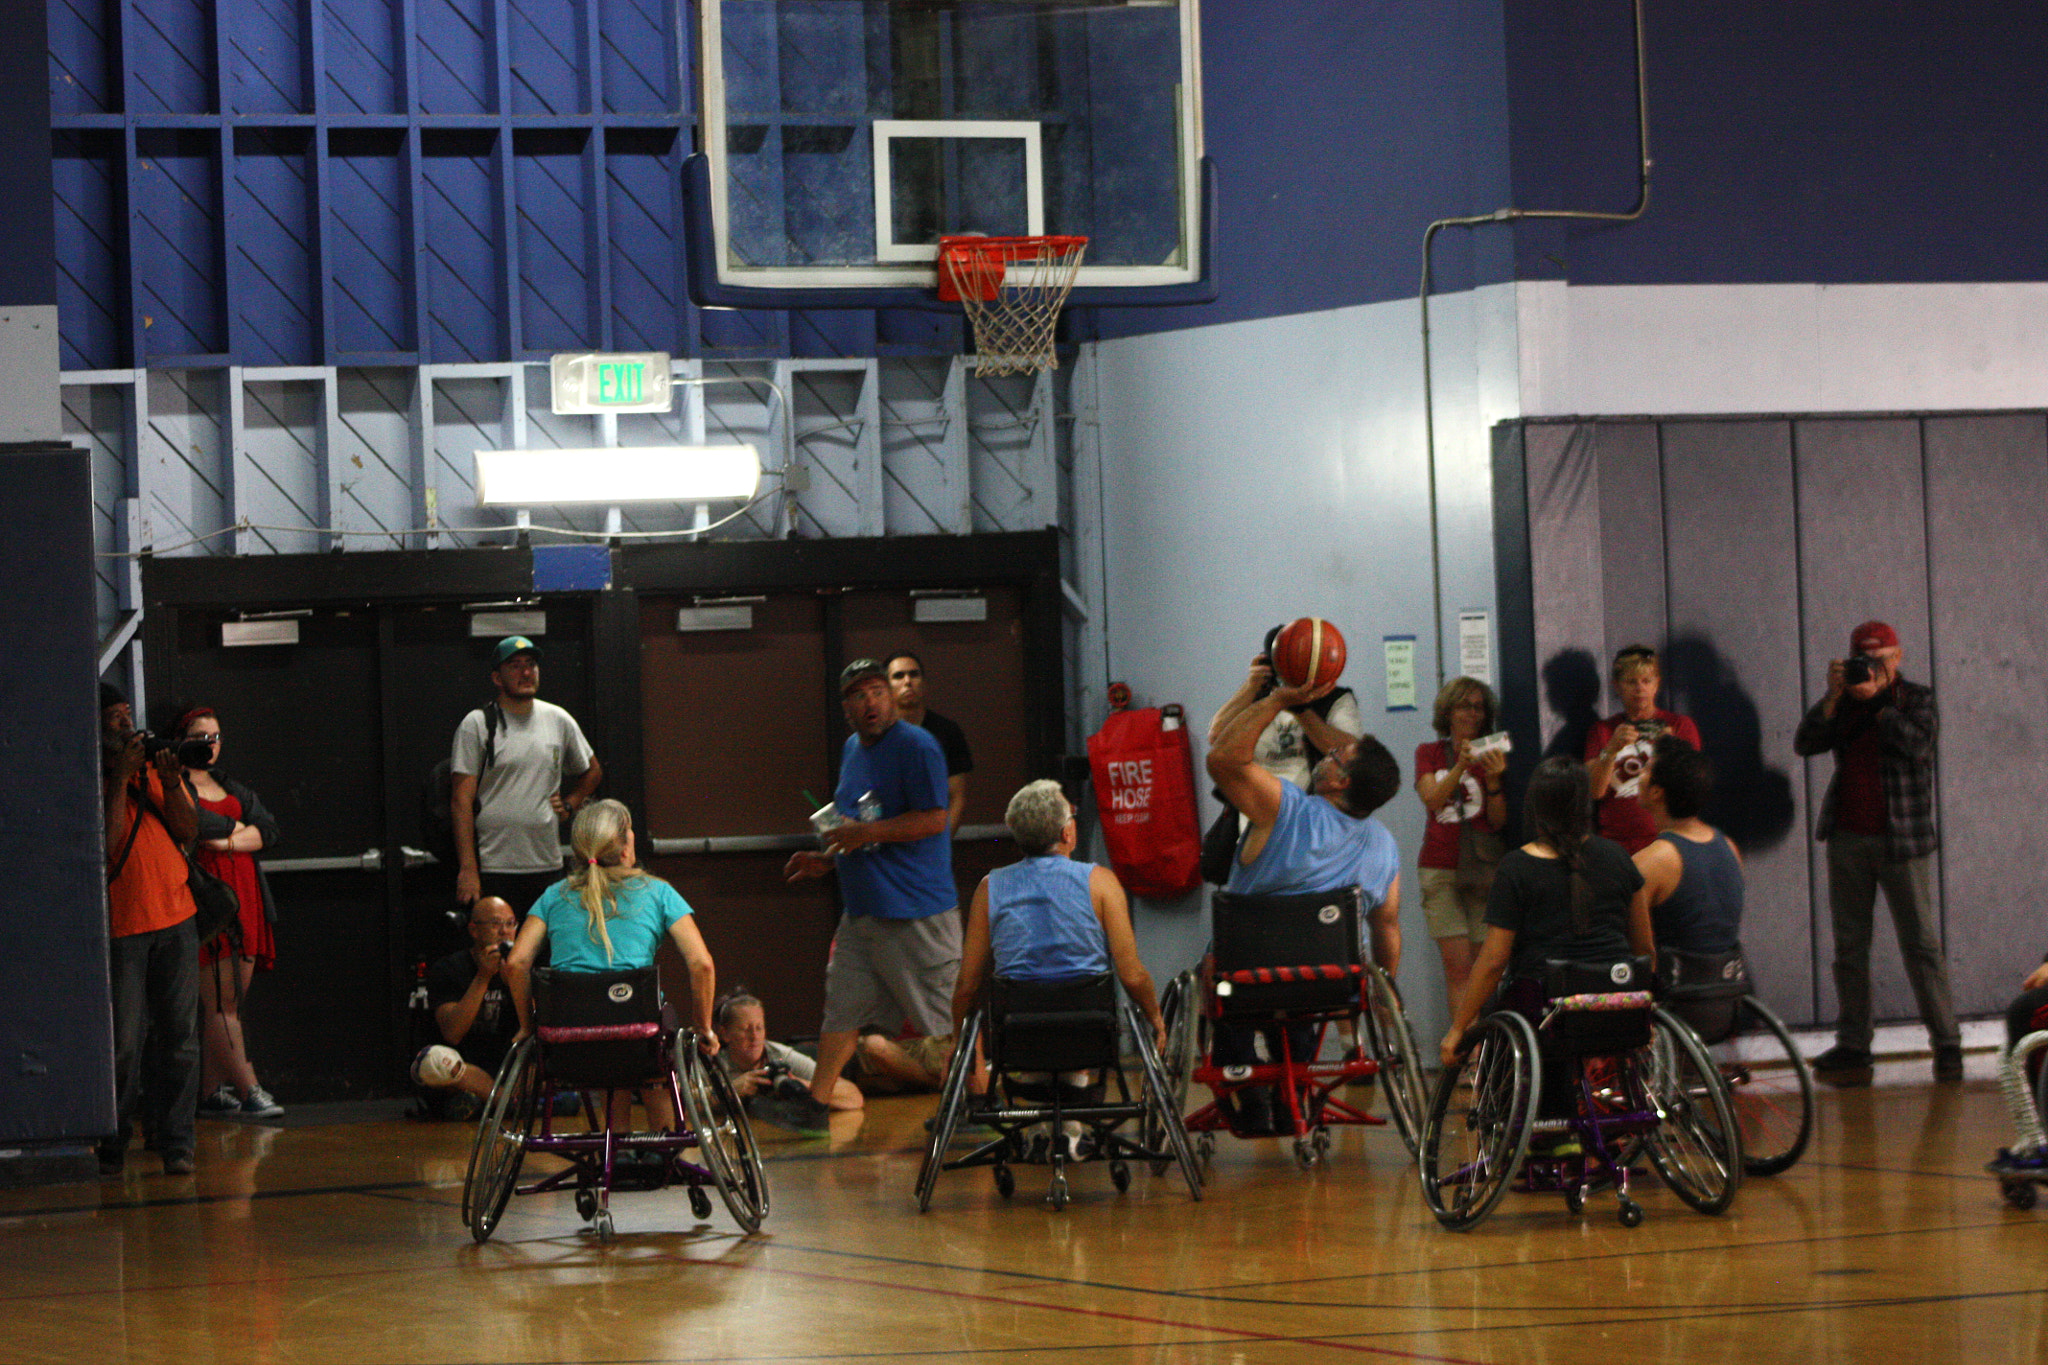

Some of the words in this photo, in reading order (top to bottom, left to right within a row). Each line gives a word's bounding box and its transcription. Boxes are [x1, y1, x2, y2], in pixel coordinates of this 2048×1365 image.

[599, 363, 645, 402] EXIT
[1108, 760, 1153, 786] FIRE
[1111, 787, 1152, 809] HOSE
